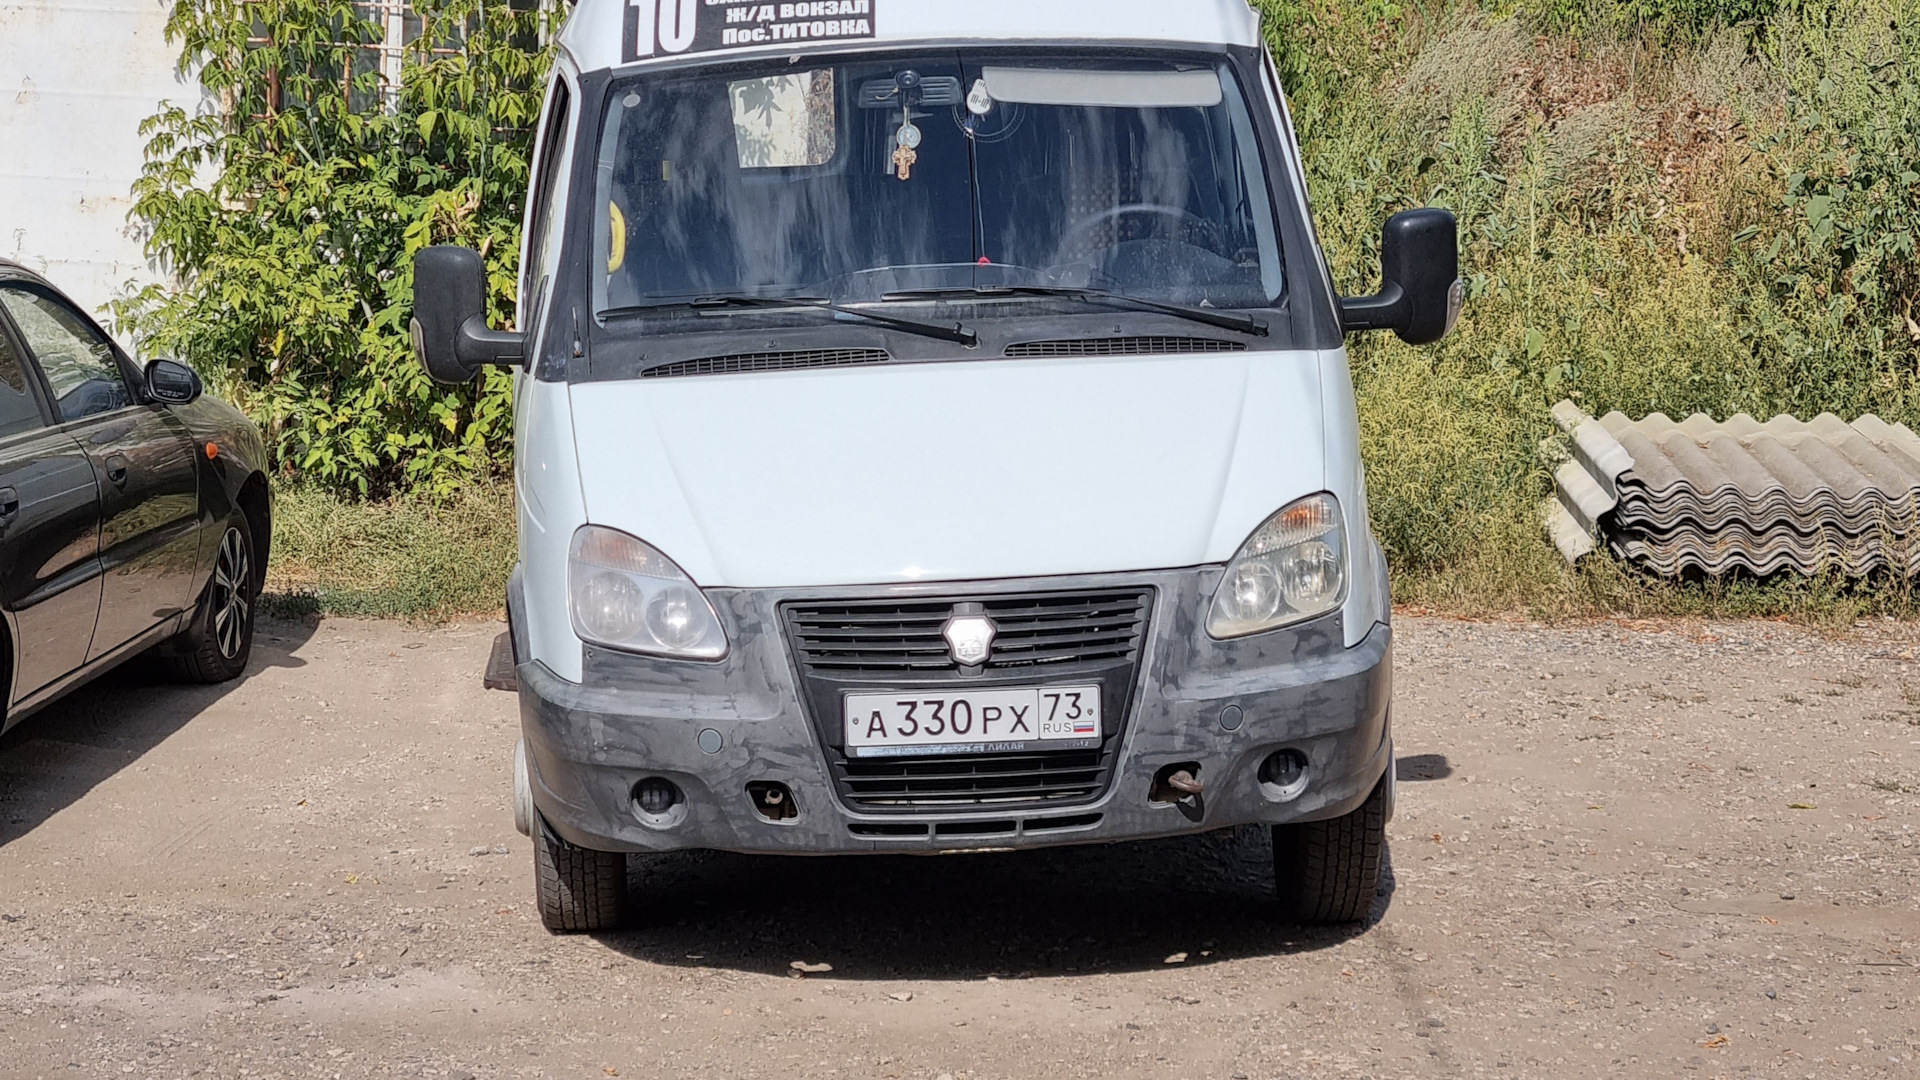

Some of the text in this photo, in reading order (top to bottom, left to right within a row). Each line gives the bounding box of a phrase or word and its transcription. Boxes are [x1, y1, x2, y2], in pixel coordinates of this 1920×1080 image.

[725, 0, 869, 23] Ж/Д ВОКЗАЛ
[631, 0, 698, 56] 10
[1043, 692, 1082, 721] 73
[1043, 722, 1072, 734] RUS
